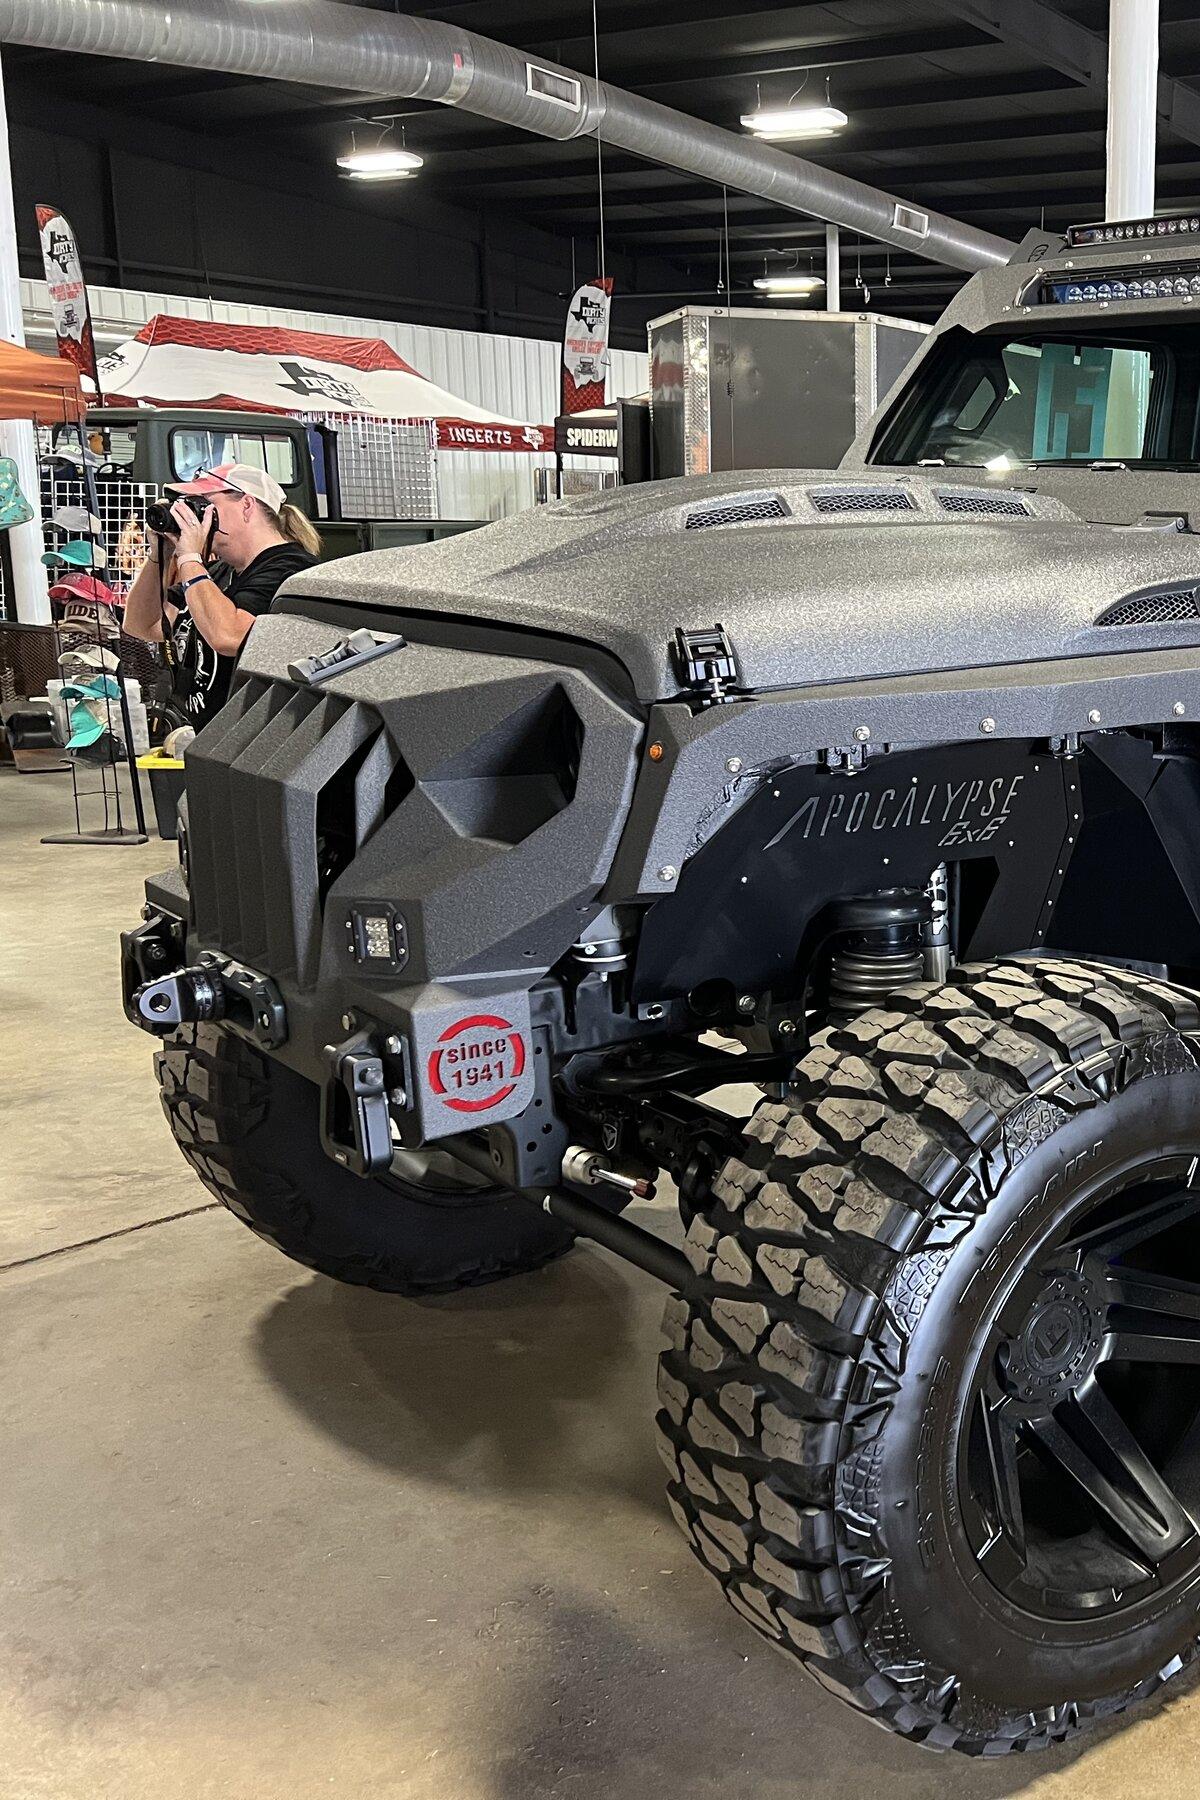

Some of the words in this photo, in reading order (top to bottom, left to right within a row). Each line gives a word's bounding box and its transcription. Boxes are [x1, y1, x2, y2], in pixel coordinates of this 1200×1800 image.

[450, 427, 512, 445] INSERTS
[567, 428, 618, 448] SPIDERW
[763, 775, 1024, 850] APOCALYPSE
[447, 1038, 507, 1063] since
[451, 1061, 504, 1088] 1941
